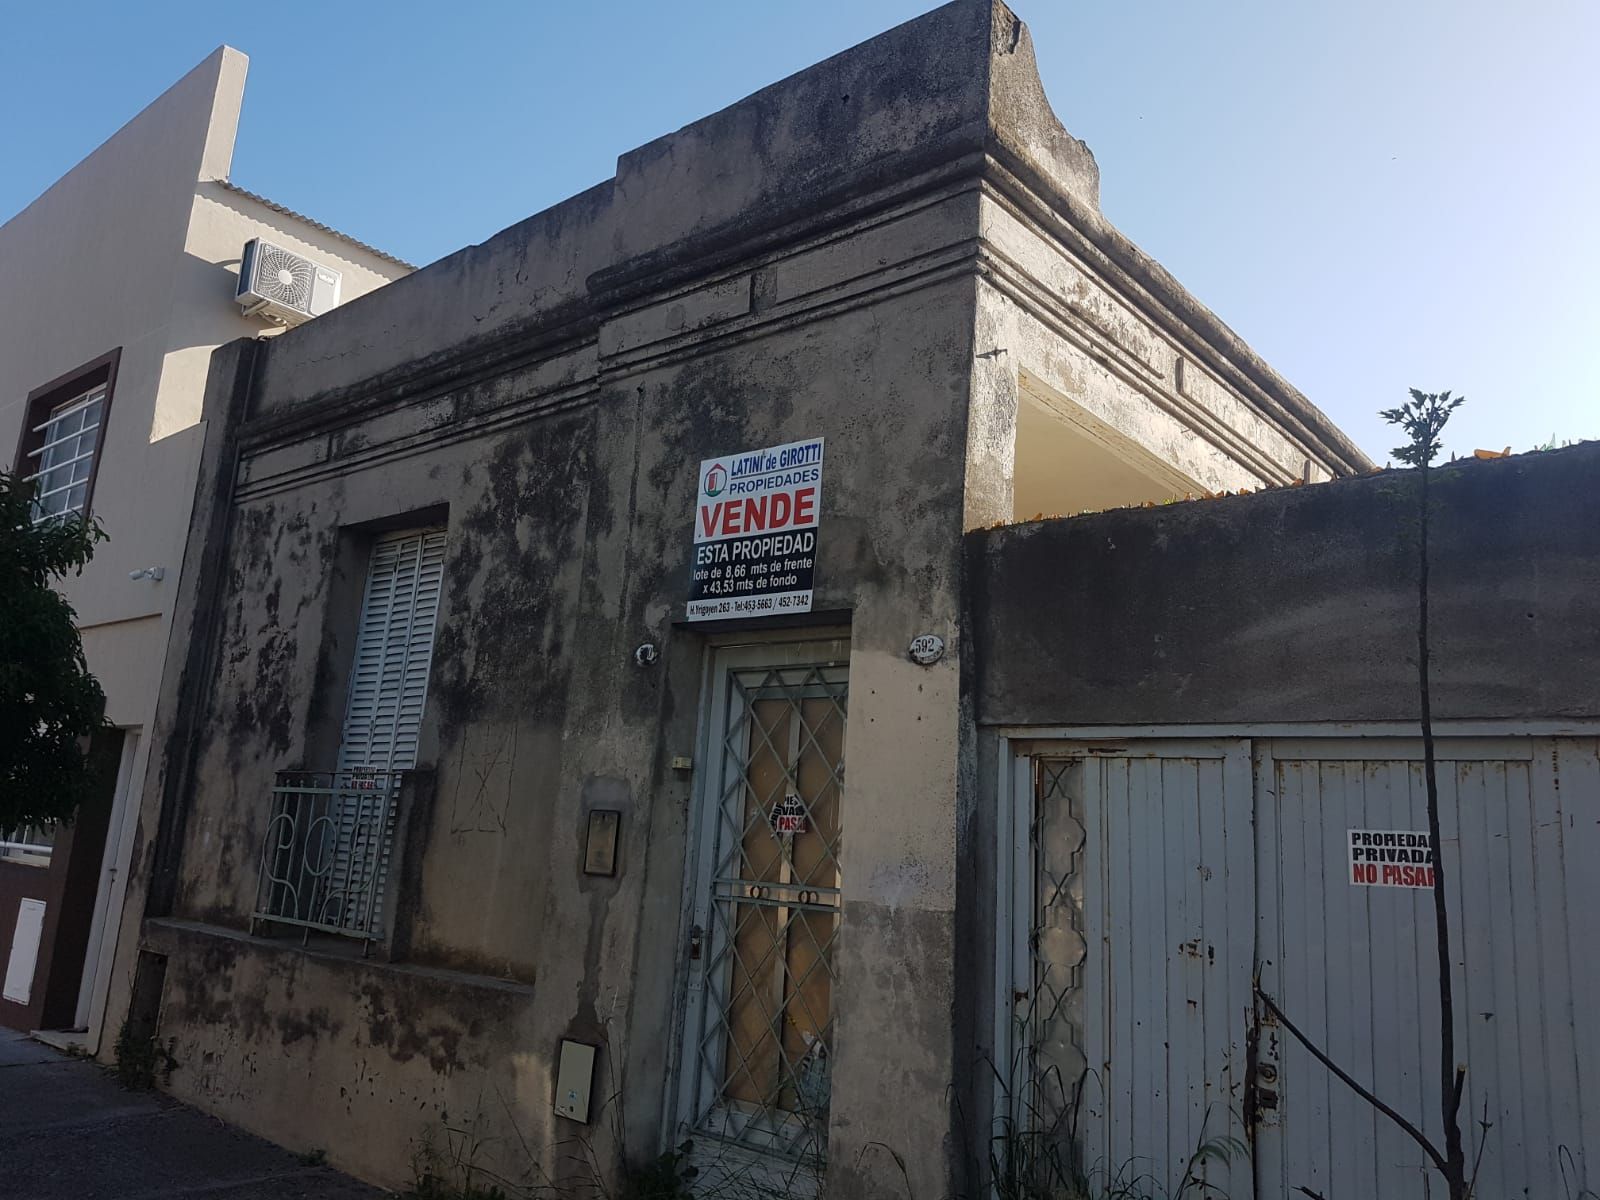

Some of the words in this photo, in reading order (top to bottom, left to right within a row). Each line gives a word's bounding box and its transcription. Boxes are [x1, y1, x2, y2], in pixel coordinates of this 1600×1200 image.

[731, 455, 764, 476] LATINI
[765, 453, 777, 470] de
[780, 443, 821, 467] GIROTTI
[729, 468, 819, 495] PROPIEDADES
[701, 487, 815, 538] VENDE
[697, 544, 729, 565] ESTA
[732, 532, 814, 560] PROPIEDAD
[693, 569, 708, 581] lote
[711, 567, 722, 579] de
[725, 564, 746, 580] 8,66
[751, 562, 768, 575] mts
[770, 560, 781, 573] de
[784, 557, 813, 571] frente
[702, 584, 709, 594] x
[710, 580, 734, 596] 43,53
[736, 578, 754, 591] mts
[756, 576, 767, 589] de
[770, 573, 797, 587] fondo
[719, 602, 730, 613] 263
[778, 595, 809, 608] 452-7342
[915, 638, 935, 653] 592
[1351, 832, 1431, 848] PROPIEDA
[1353, 863, 1378, 884] NO
